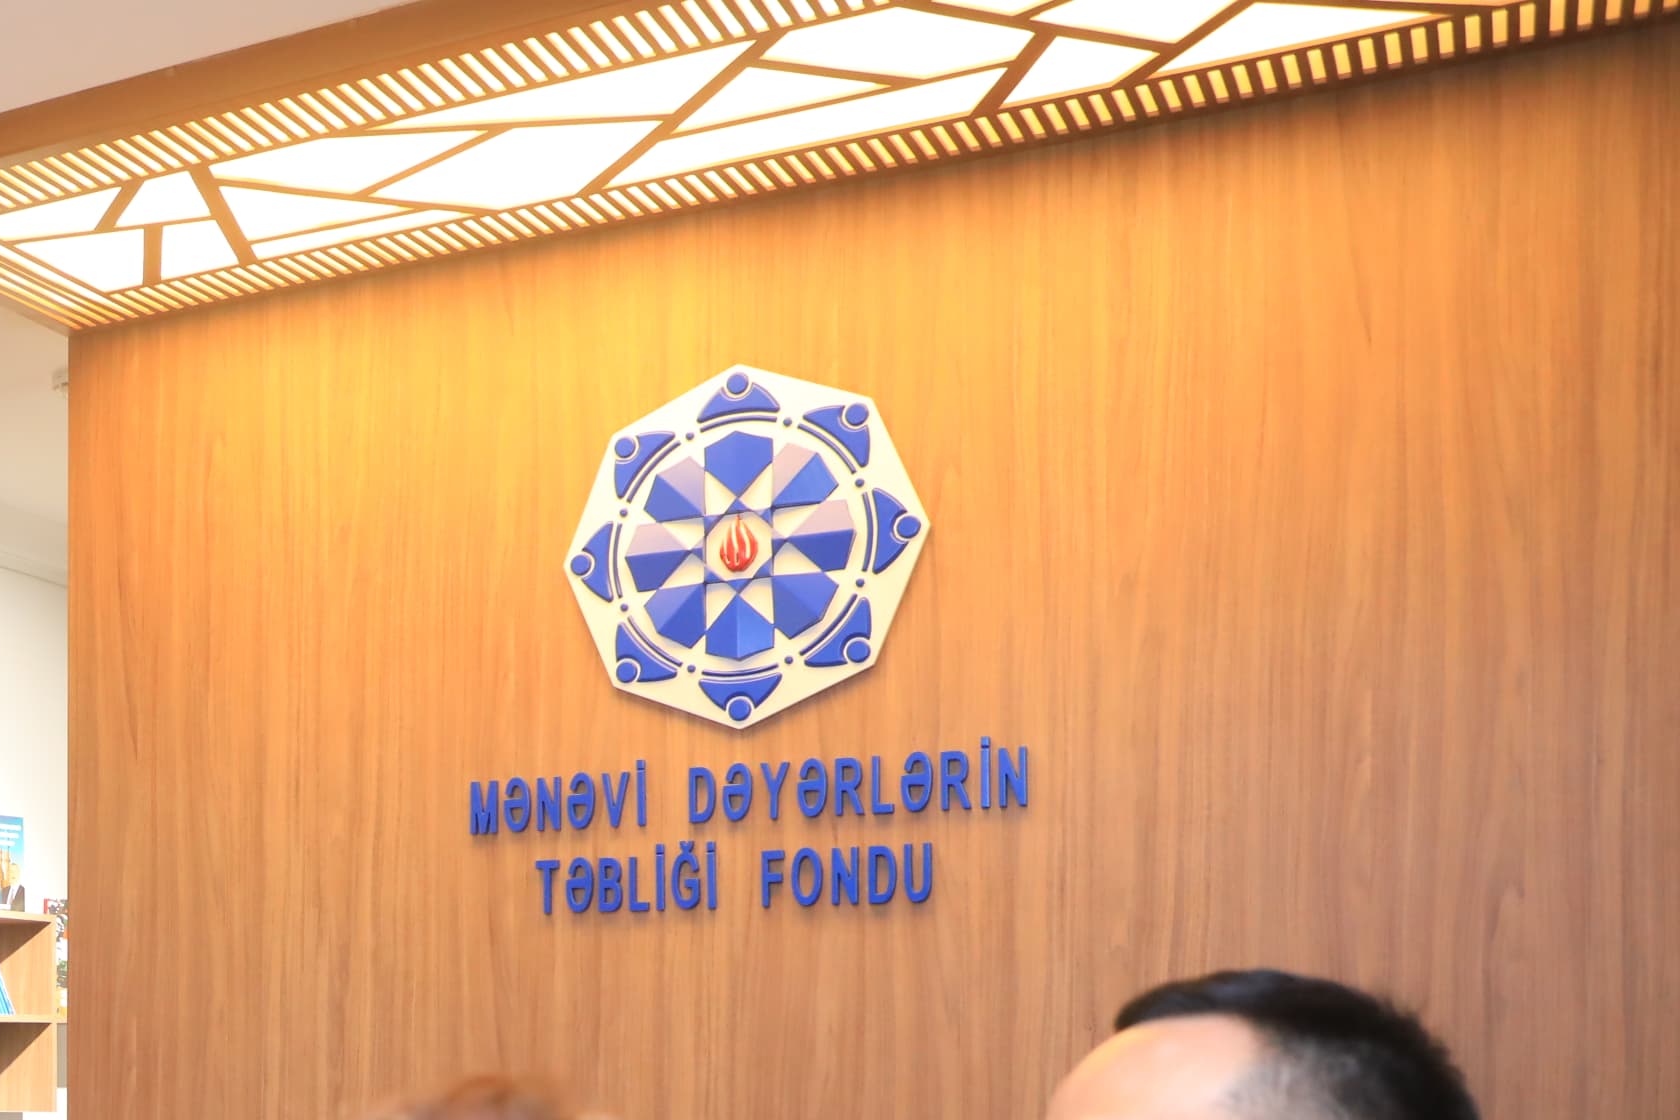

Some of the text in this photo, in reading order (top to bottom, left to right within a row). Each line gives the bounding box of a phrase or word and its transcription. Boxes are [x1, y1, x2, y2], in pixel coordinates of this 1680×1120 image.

[469, 736, 1030, 835] MƏNƏVİ DƏYƏRLƏRİN
[535, 840, 933, 915] TƏBLİĞİ FONDU
